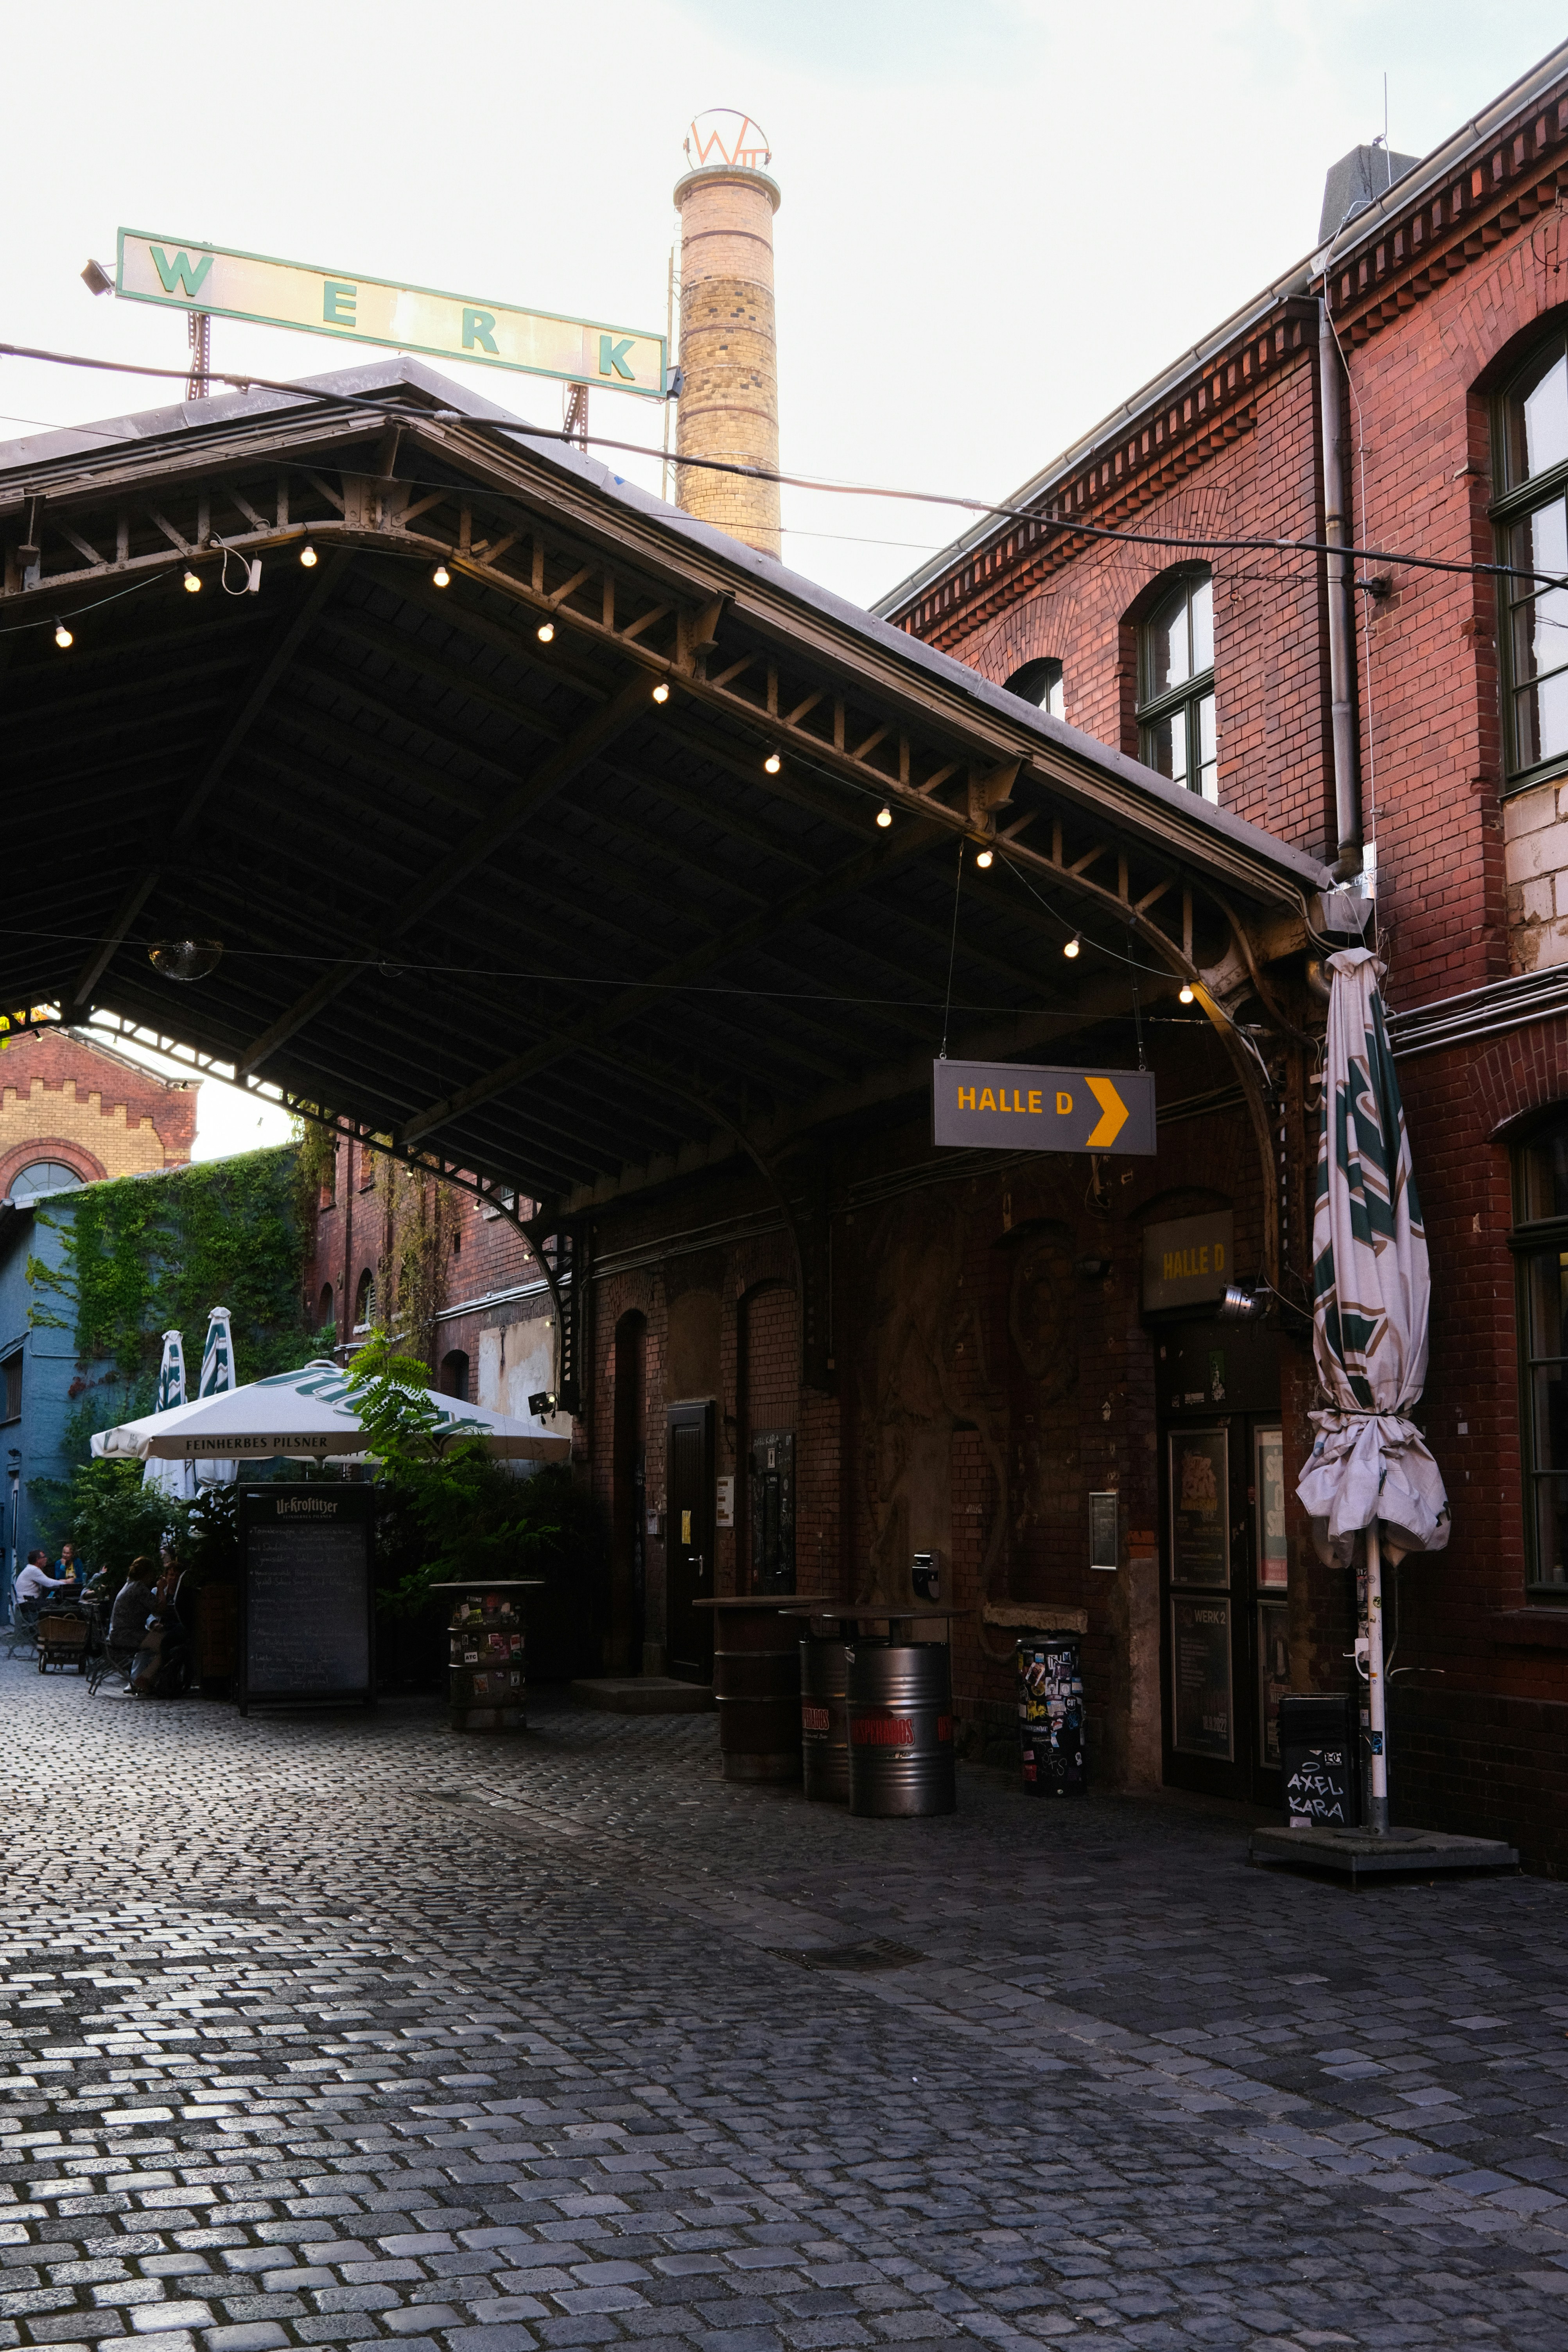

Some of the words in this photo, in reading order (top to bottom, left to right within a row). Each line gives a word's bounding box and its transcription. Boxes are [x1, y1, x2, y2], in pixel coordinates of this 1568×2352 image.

[149, 246, 636, 380] WERK
[958, 1086, 1042, 1113] HALLE
[1057, 1092, 1073, 1114] D
[1163, 1246, 1208, 1280] HALLE
[1214, 1242, 1225, 1272] D
[186, 1437, 267, 1450] FEINHERBES
[274, 1437, 327, 1447] PILSNER
[1194, 1609, 1219, 1624] WERK
[1220, 1611, 1226, 1624] 2
[850, 1717, 915, 1747] DESPERADOS
[1287, 1773, 1344, 1796] AXEL
[1288, 1796, 1345, 1823] KARA
